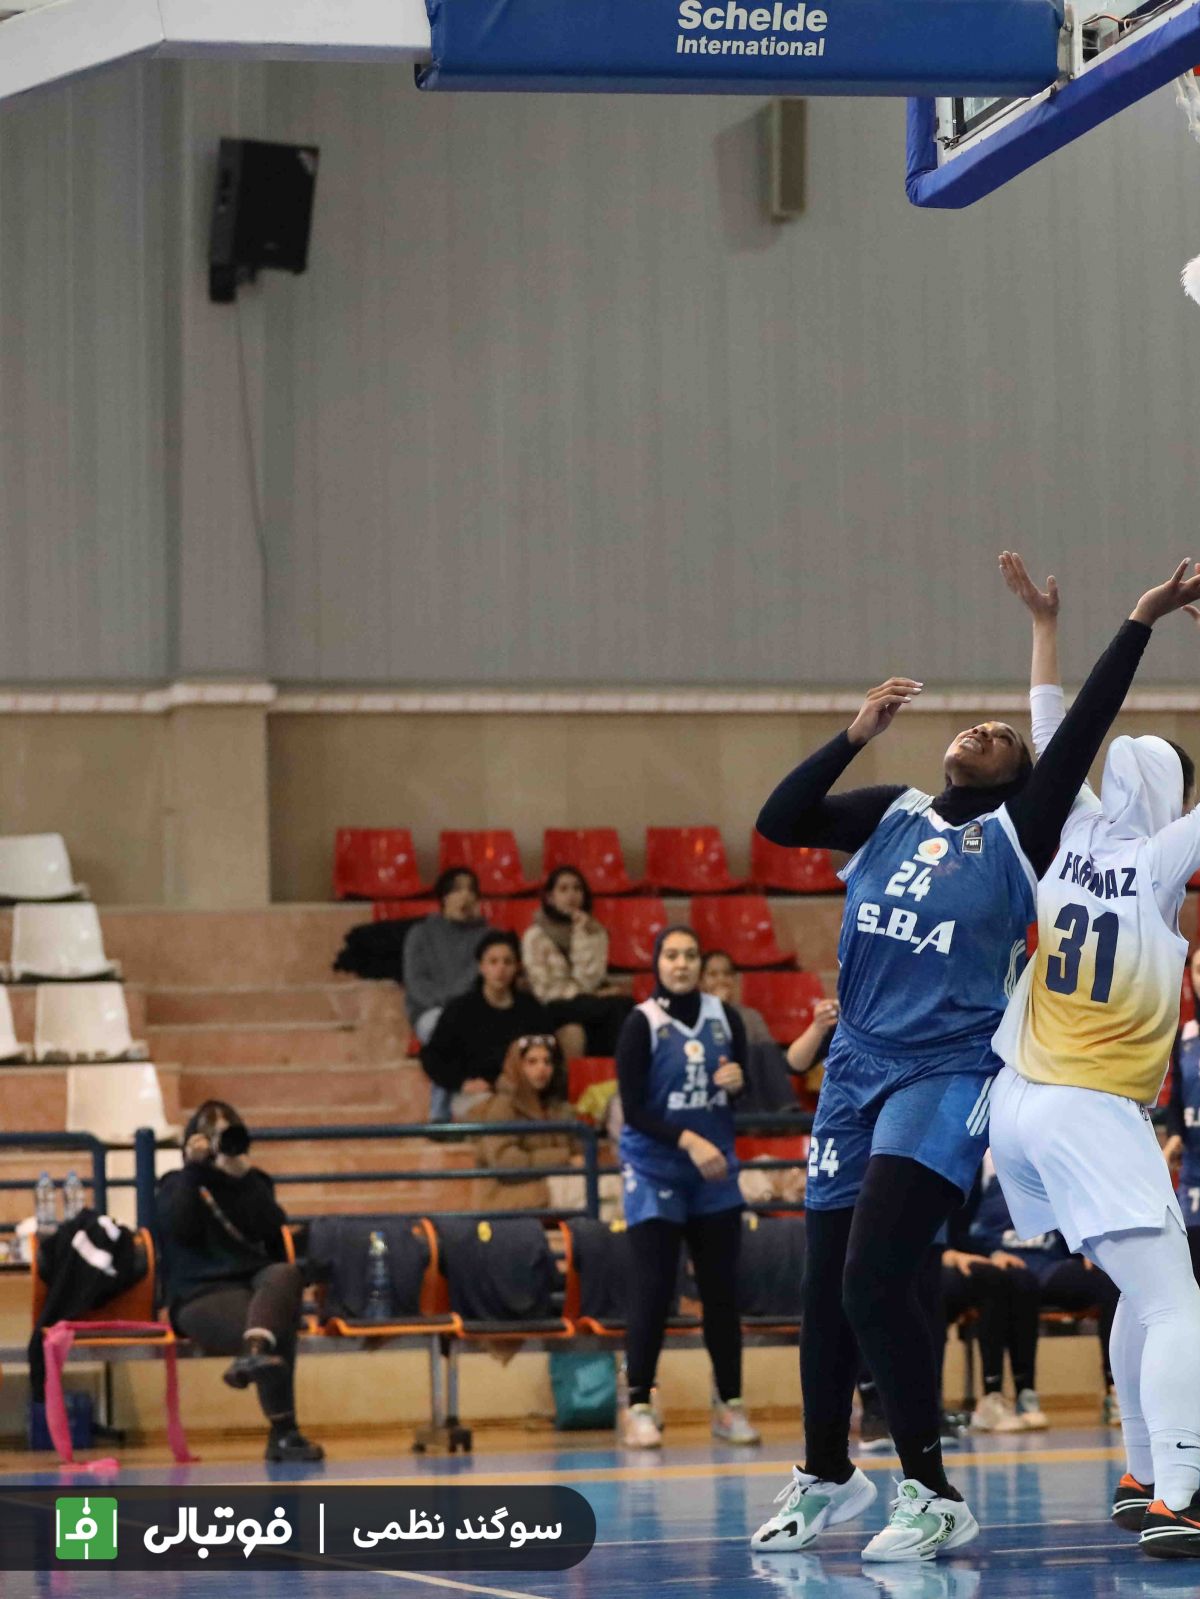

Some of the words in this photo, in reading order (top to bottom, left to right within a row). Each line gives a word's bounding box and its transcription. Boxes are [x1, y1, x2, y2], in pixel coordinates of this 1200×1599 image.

[677, 0, 828, 32] Schelde
[676, 34, 825, 57] International
[884, 860, 933, 902] 24
[857, 902, 956, 955] S.B.A
[1045, 902, 1120, 1004] 31
[808, 1135, 840, 1178] 24
